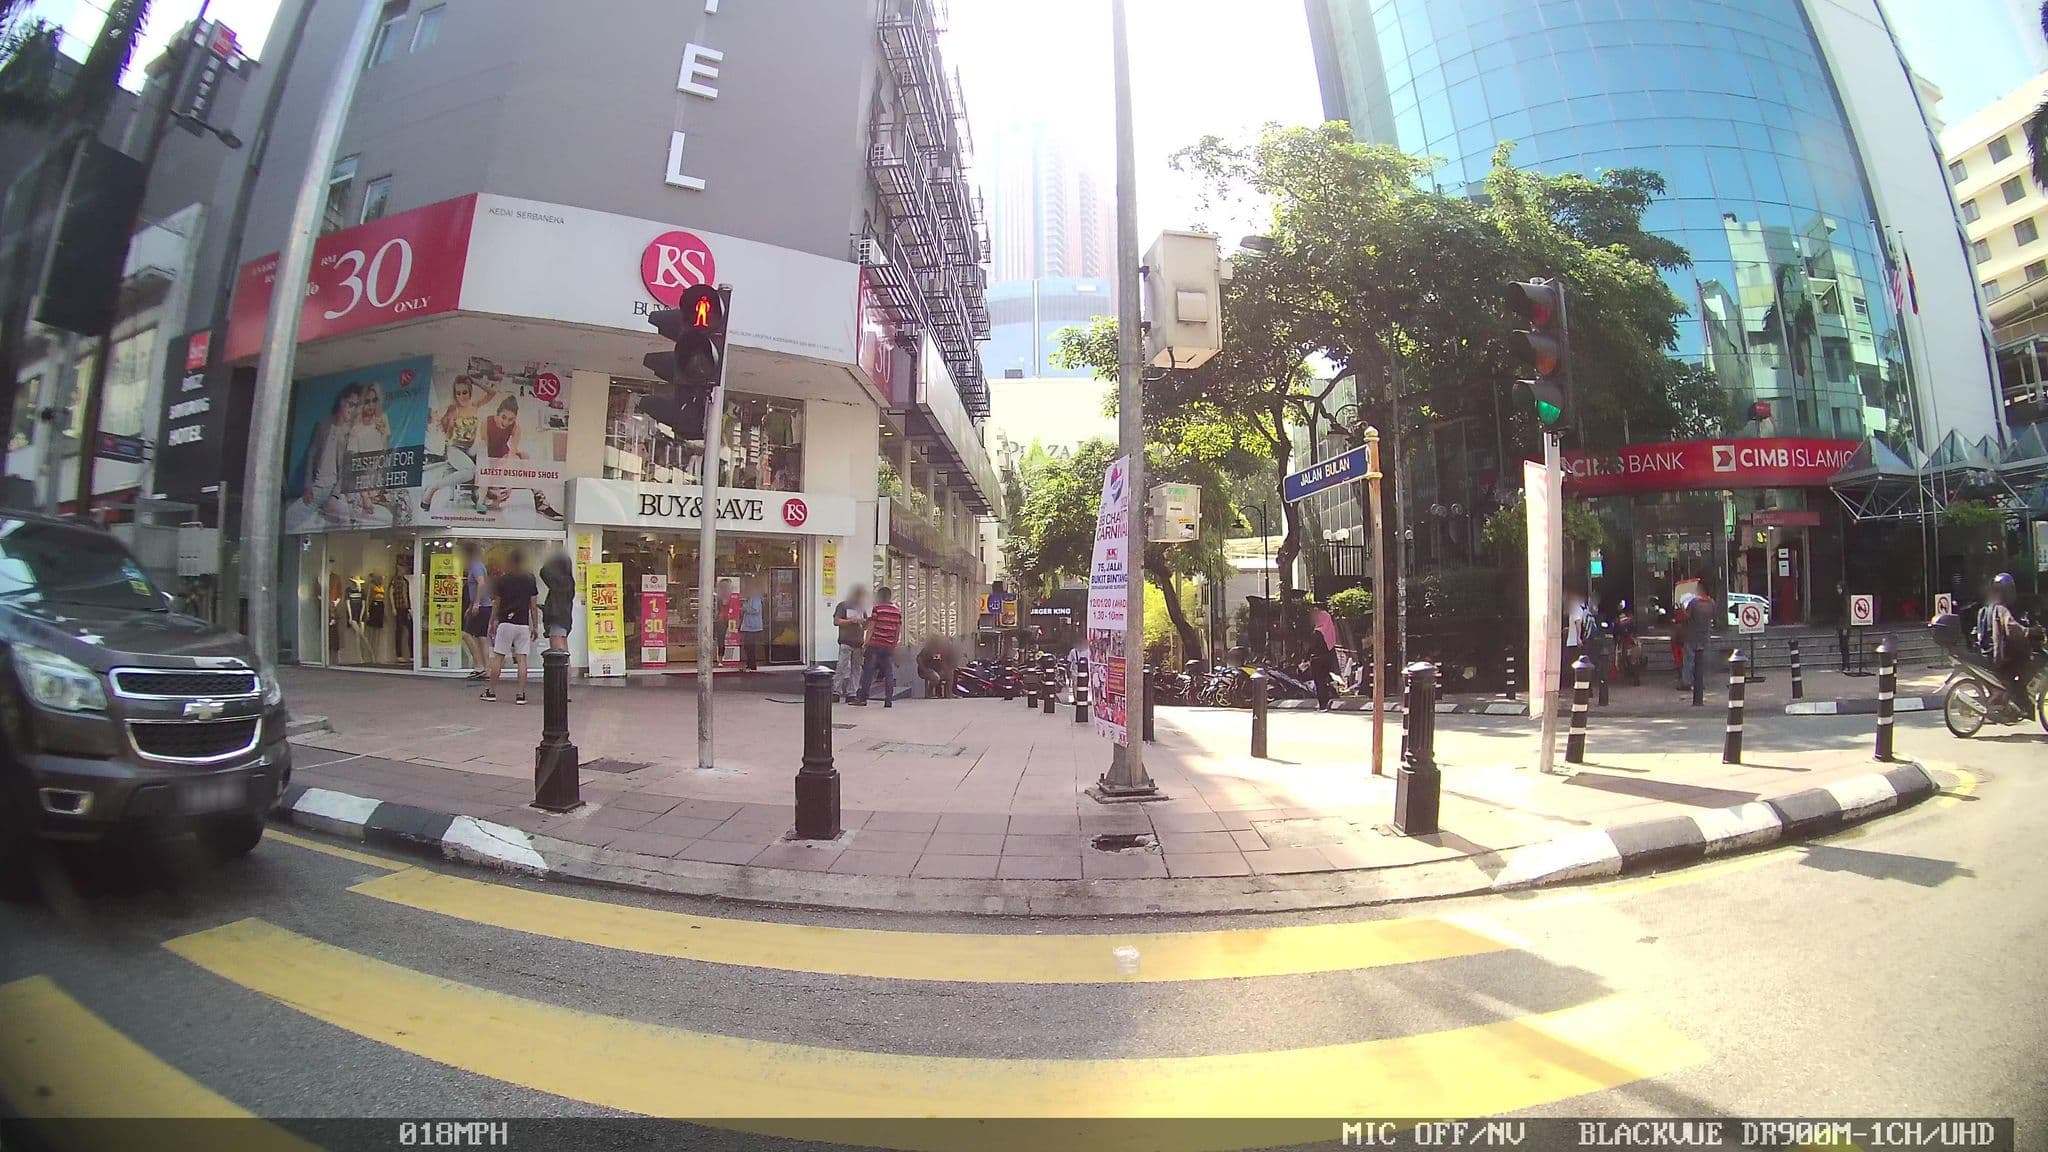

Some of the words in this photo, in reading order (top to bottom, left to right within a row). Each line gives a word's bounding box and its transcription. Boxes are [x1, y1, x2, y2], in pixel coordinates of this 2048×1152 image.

[488, 207, 514, 217] KEDAI
[516, 210, 565, 224] SERBANEKA
[324, 238, 413, 320] 30
[394, 296, 431, 313] ONLY
[351, 454, 392, 472] FASHION
[392, 451, 415, 467] FOR
[1629, 451, 1686, 474] BANK
[1740, 448, 1789, 468] CIMB
[1791, 448, 1854, 469] ISLAMIC
[385, 470, 408, 487] HER
[480, 468, 502, 477] LATEST
[503, 469, 537, 478] DESIGNED
[537, 471, 560, 480] SHOES
[1300, 467, 1323, 487] JALAN
[1324, 456, 1350, 478] BULAN
[1053, 607, 1071, 615] KING
